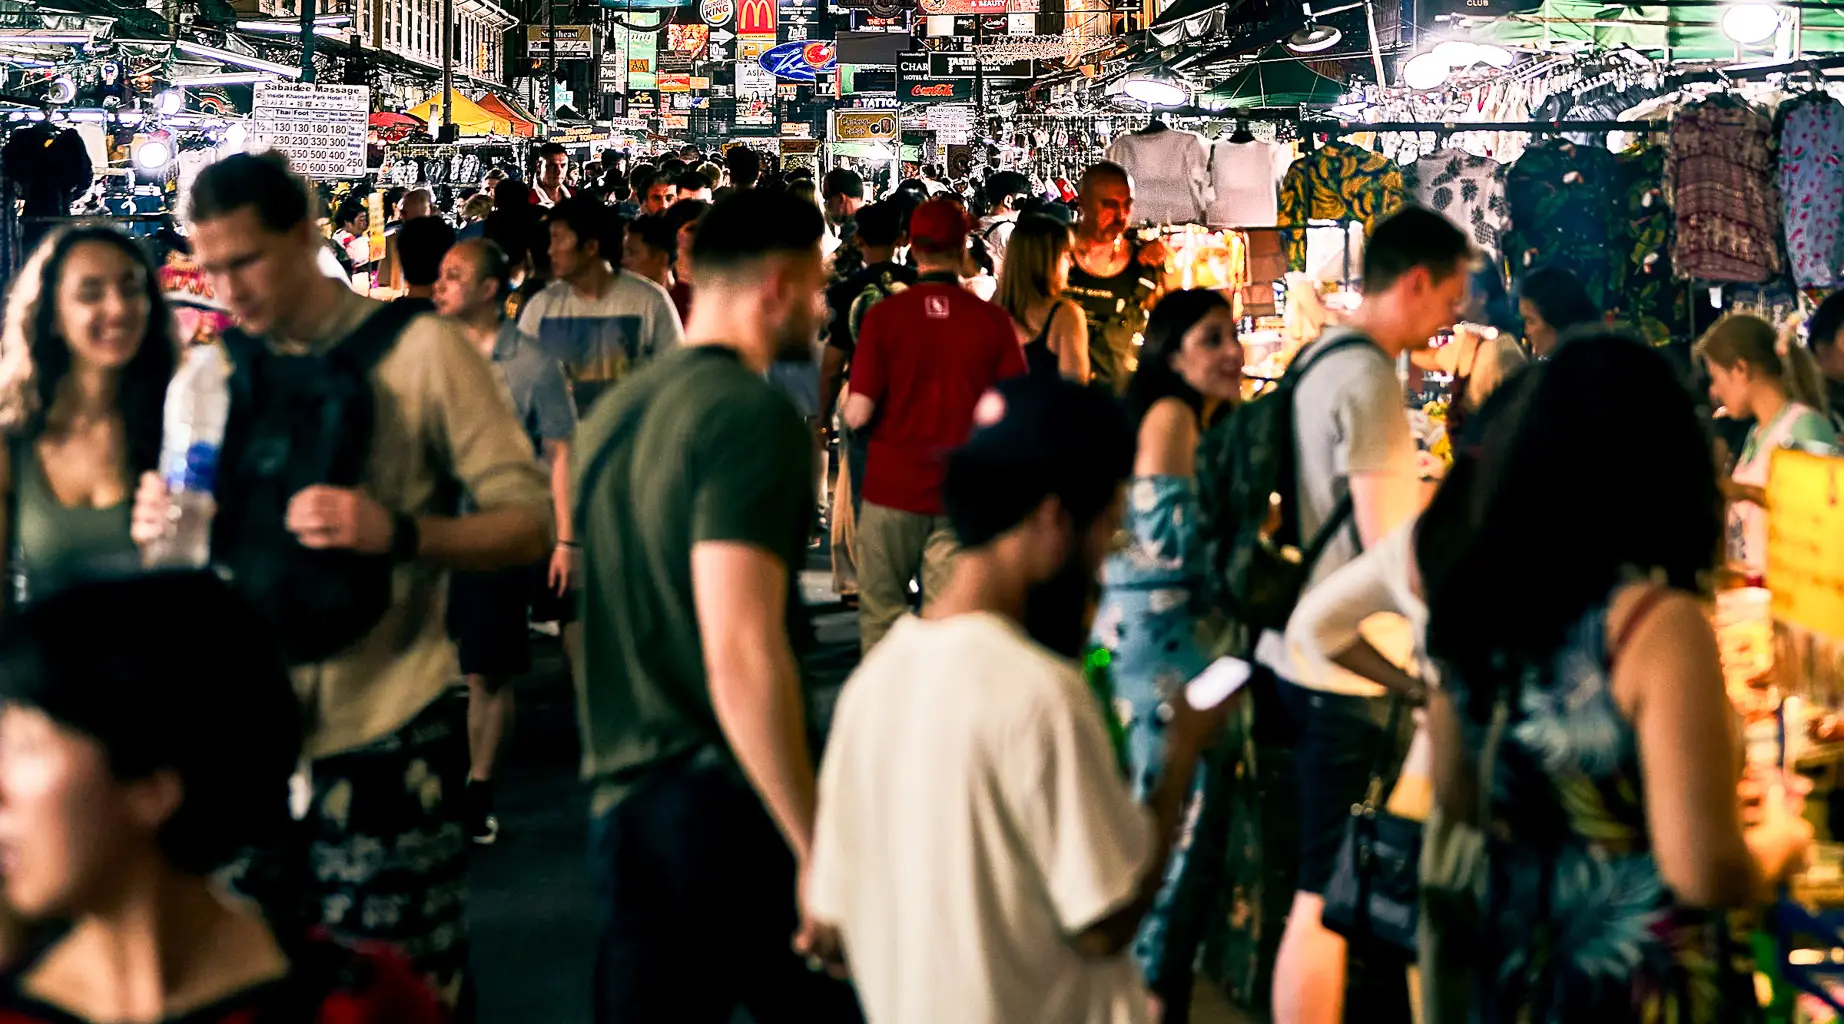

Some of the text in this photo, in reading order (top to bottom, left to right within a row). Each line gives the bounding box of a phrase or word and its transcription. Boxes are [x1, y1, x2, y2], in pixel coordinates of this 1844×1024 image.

[979, 0, 1005, 7] BEAUTY
[705, 5, 729, 19] KING
[264, 83, 360, 95] Sabaidee Massage
[911, 84, 955, 96] Coca-Cola
[274, 123, 347, 135] 130 130 180 180
[273, 135, 290, 145] 230
[292, 136, 309, 146] 230
[311, 137, 327, 147] 330
[329, 138, 346, 148] 300
[291, 149, 345, 160] 350 500 400
[290, 162, 307, 172] 450
[310, 163, 326, 173] 600
[328, 164, 345, 173] 500
[346, 158, 363, 167] 250
